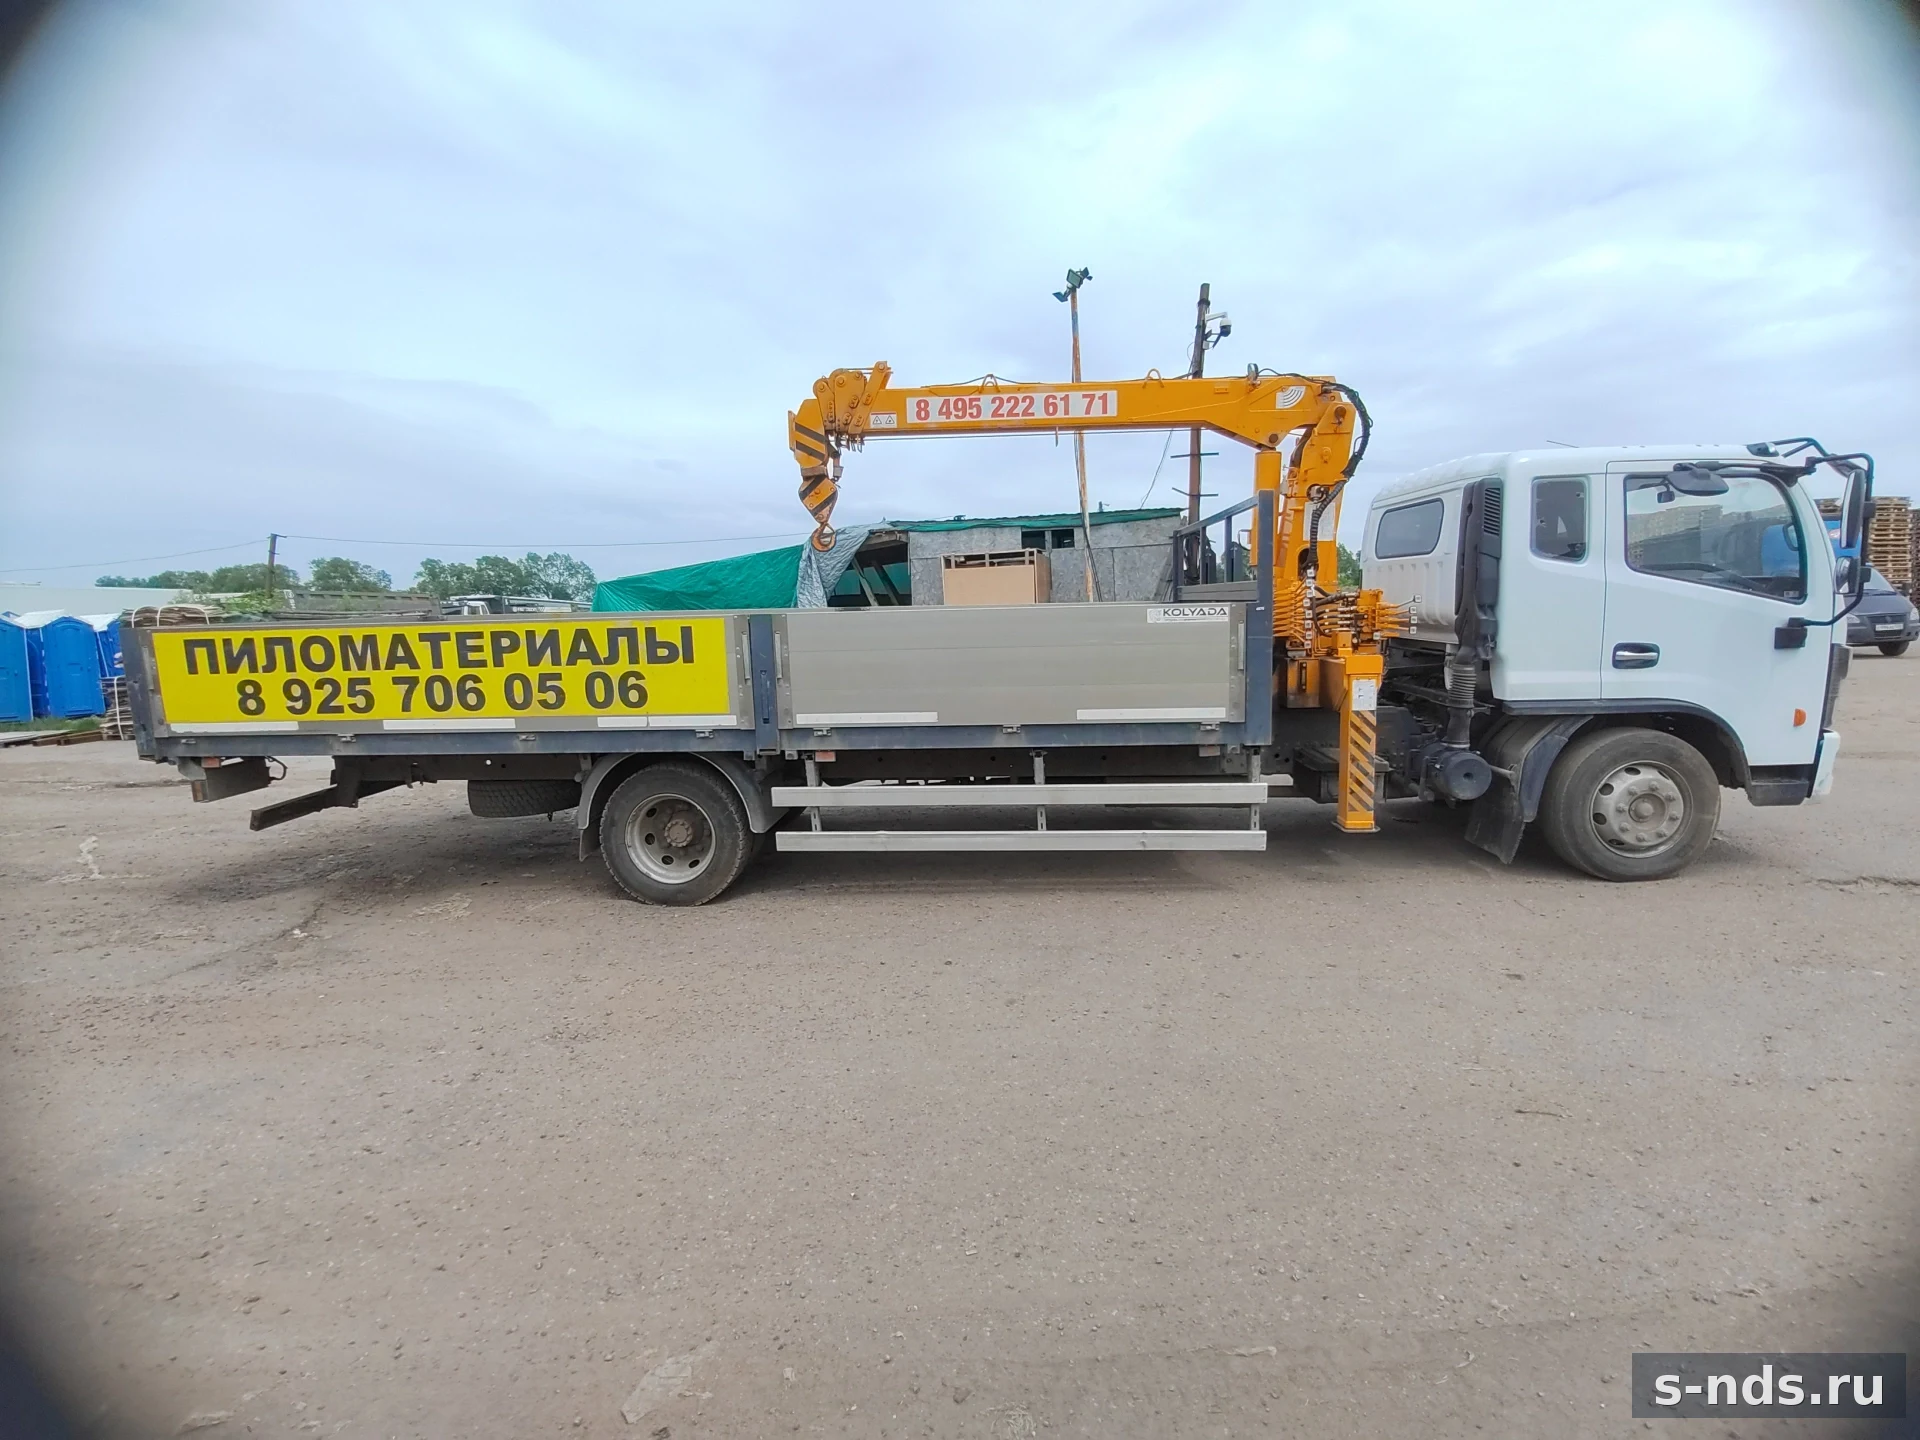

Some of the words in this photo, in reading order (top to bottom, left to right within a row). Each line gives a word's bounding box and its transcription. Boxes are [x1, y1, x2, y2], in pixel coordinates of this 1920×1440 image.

[915, 399, 930, 421] 8
[939, 398, 982, 420] 495
[992, 396, 1035, 418] 222
[1044, 395, 1070, 416] 61
[1082, 393, 1108, 415] 71
[1163, 608, 1227, 616] KOLYADA
[184, 626, 694, 675] ПИЛОМАТЕРИАЛЫ
[236, 679, 266, 716] 8
[281, 677, 376, 715] 925
[391, 674, 486, 713] 706
[504, 672, 565, 711] 05
[585, 671, 649, 709] 06
